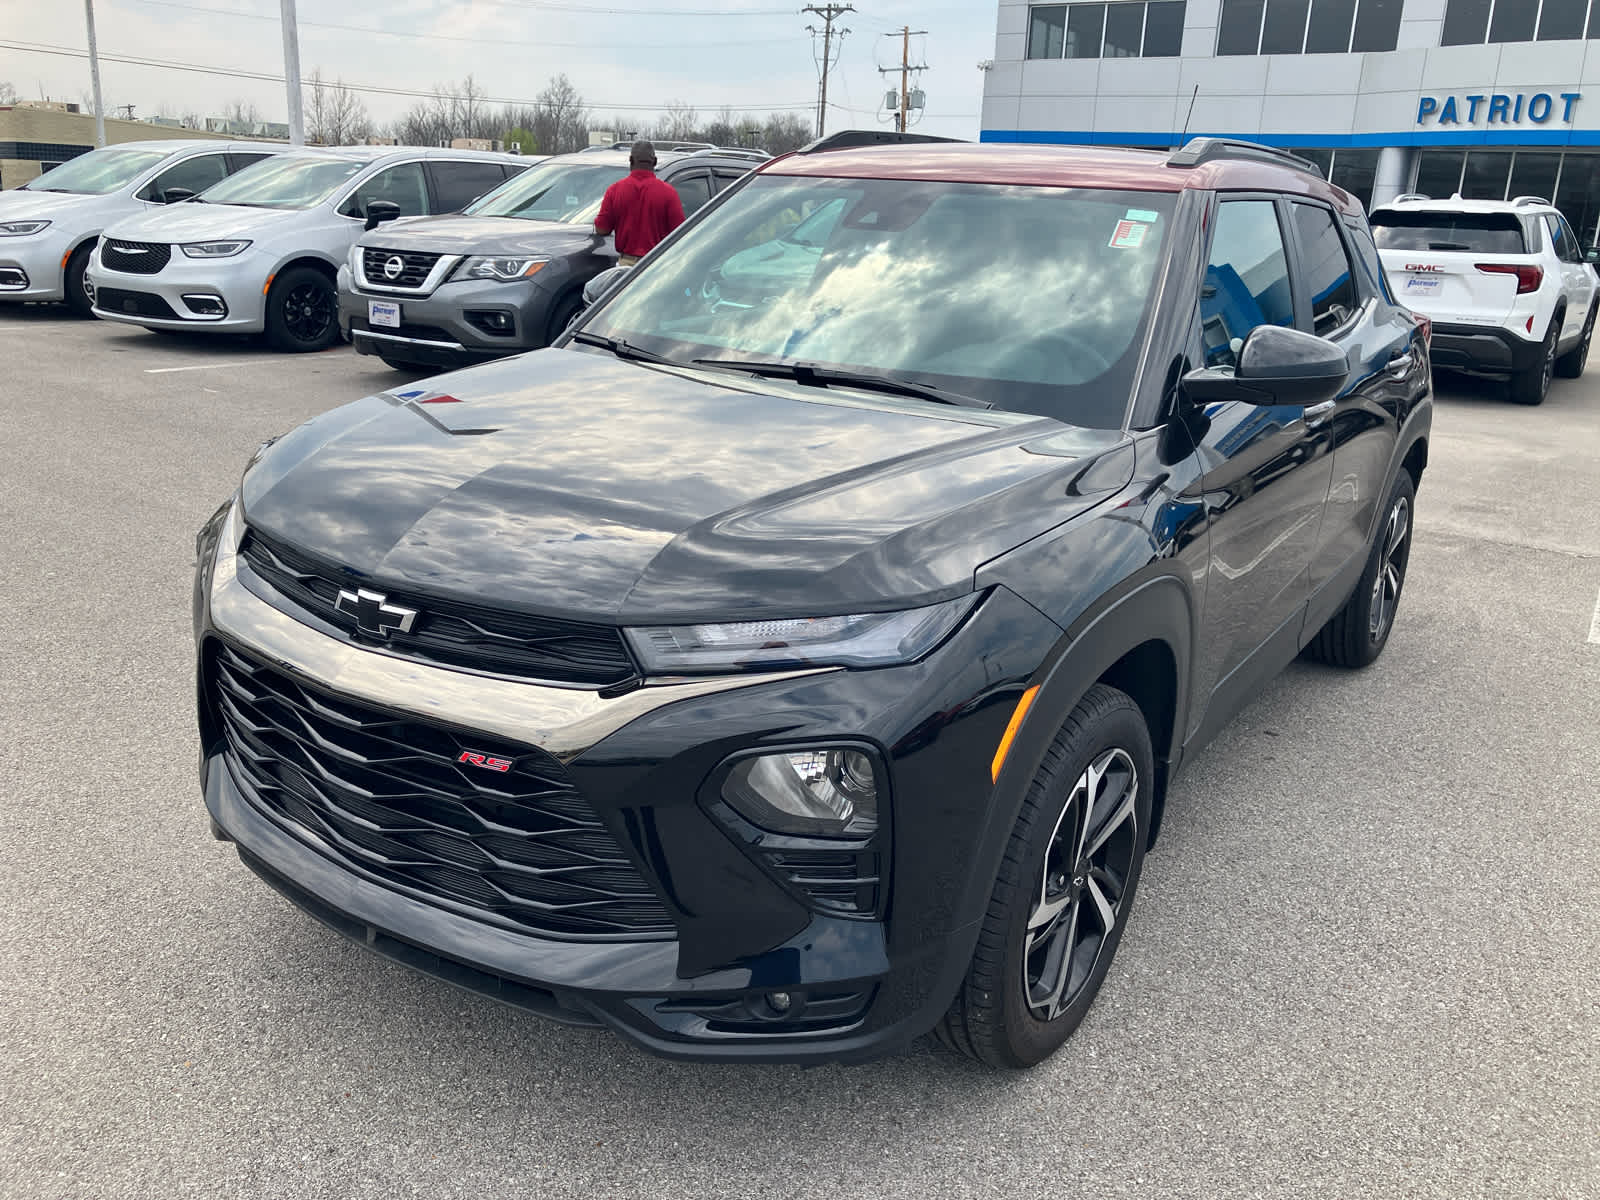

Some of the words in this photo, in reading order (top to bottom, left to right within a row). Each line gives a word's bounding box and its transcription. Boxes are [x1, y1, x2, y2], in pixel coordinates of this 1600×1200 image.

[1416, 93, 1582, 125] PATRIOT
[1405, 263, 1445, 273] GMC
[458, 751, 513, 773] RS
